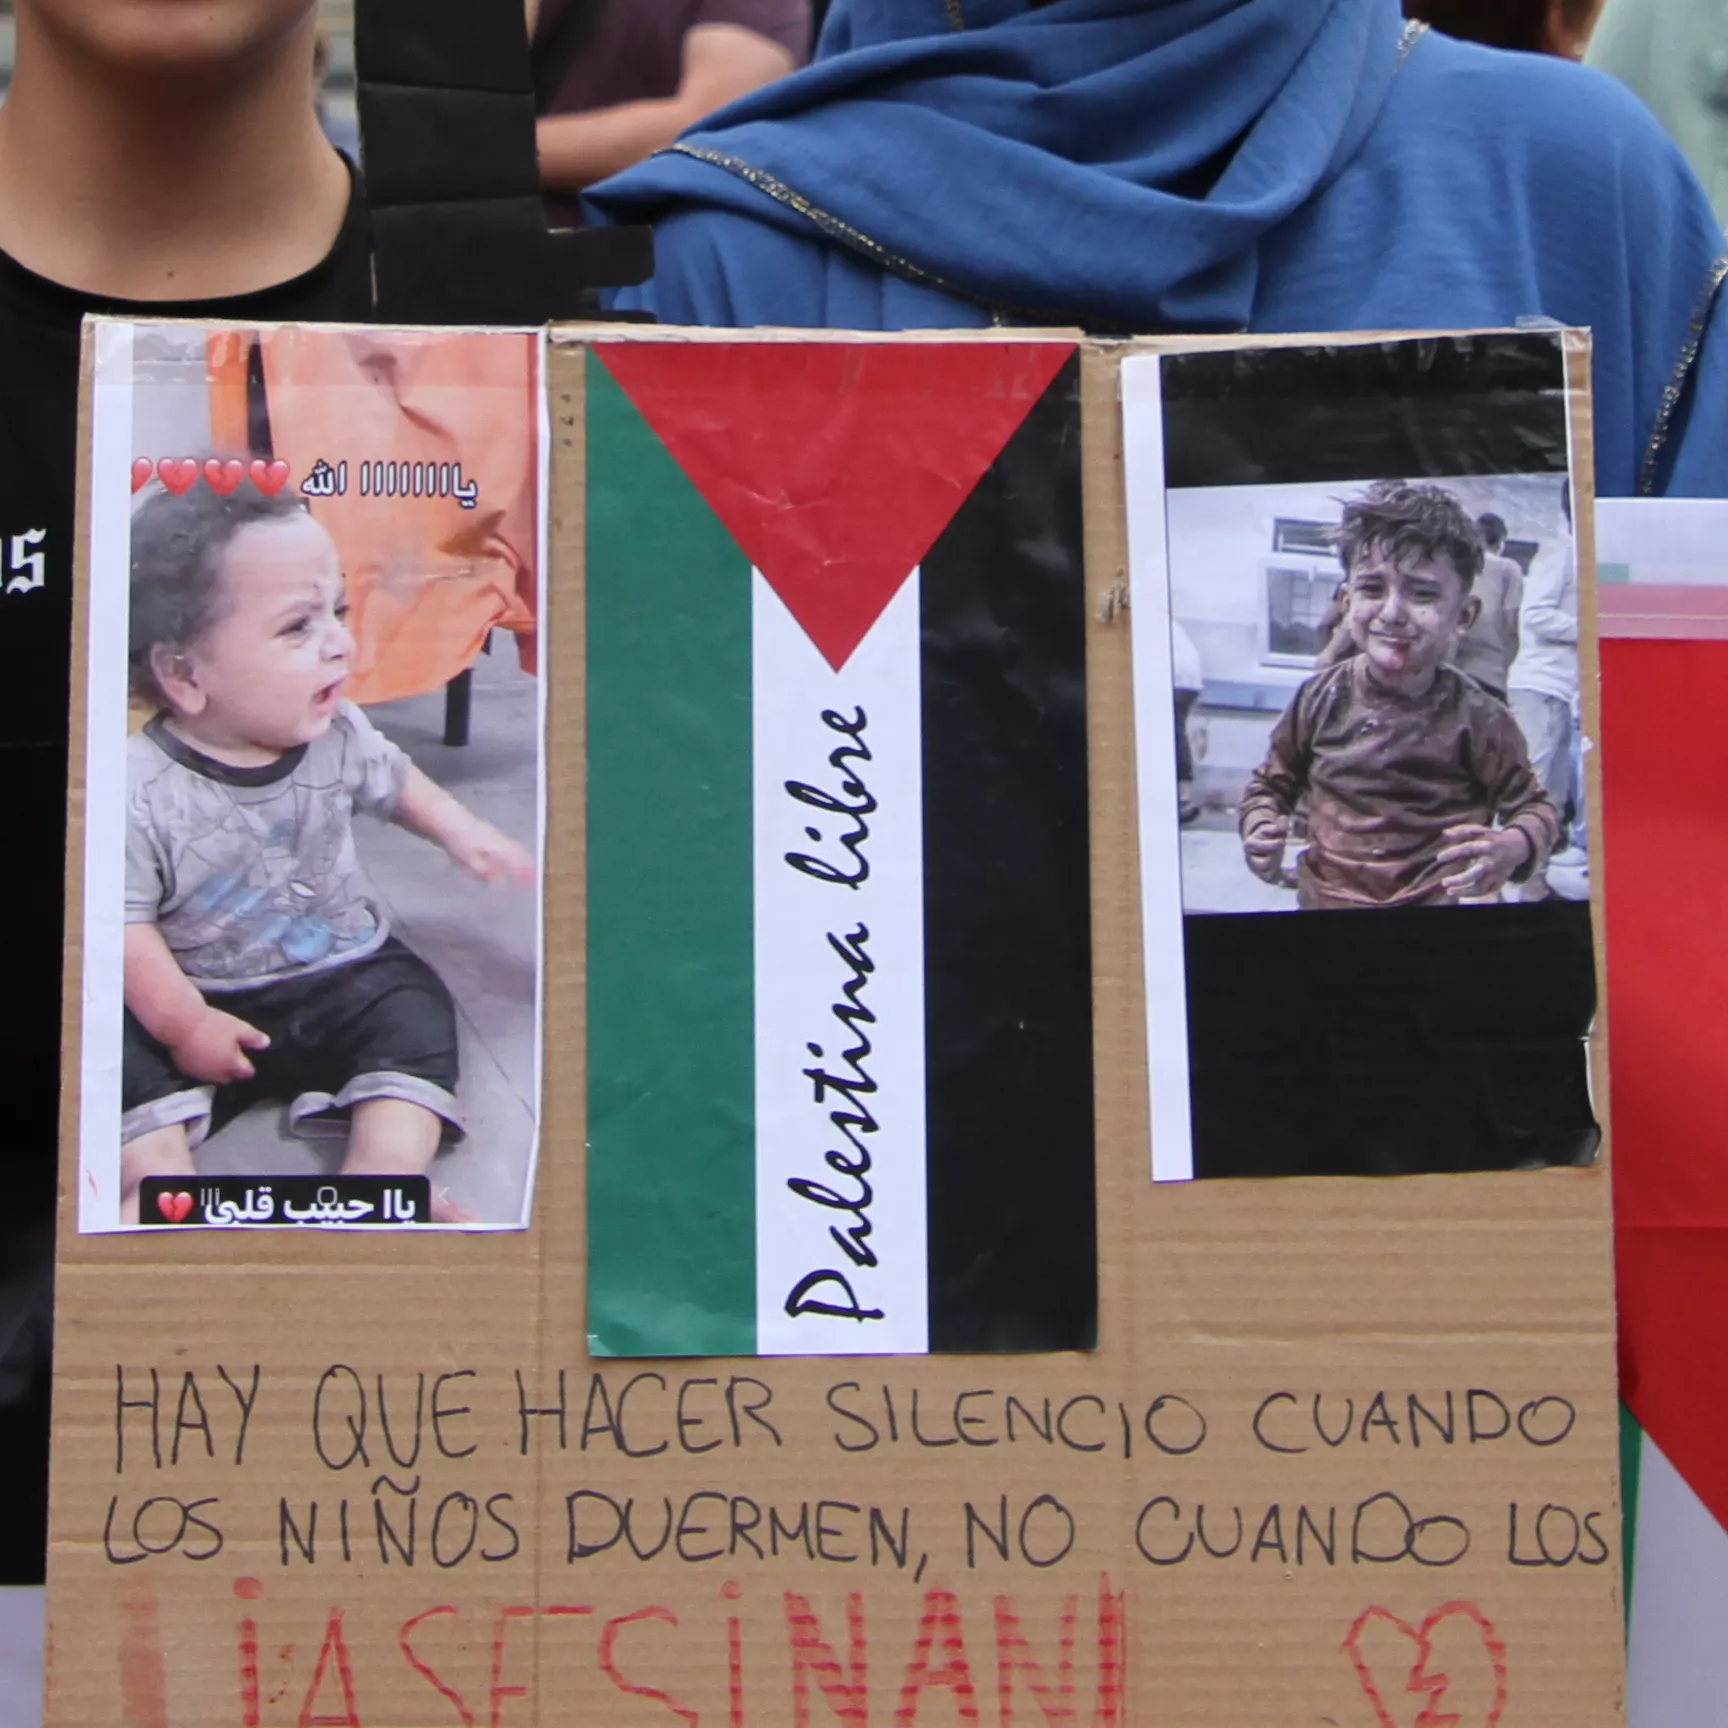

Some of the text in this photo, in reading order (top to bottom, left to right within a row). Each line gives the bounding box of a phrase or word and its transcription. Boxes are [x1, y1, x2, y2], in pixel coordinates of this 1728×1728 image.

[299, 457, 349, 497] الله
[784, 705, 885, 1325] Palestina libre
[117, 1364, 1576, 1473] HAY QUE HACER SILENCIO CUANDO
[103, 1474, 1611, 1584] LOS NIÑOS DUERMEN, NO CUANDO LOS
